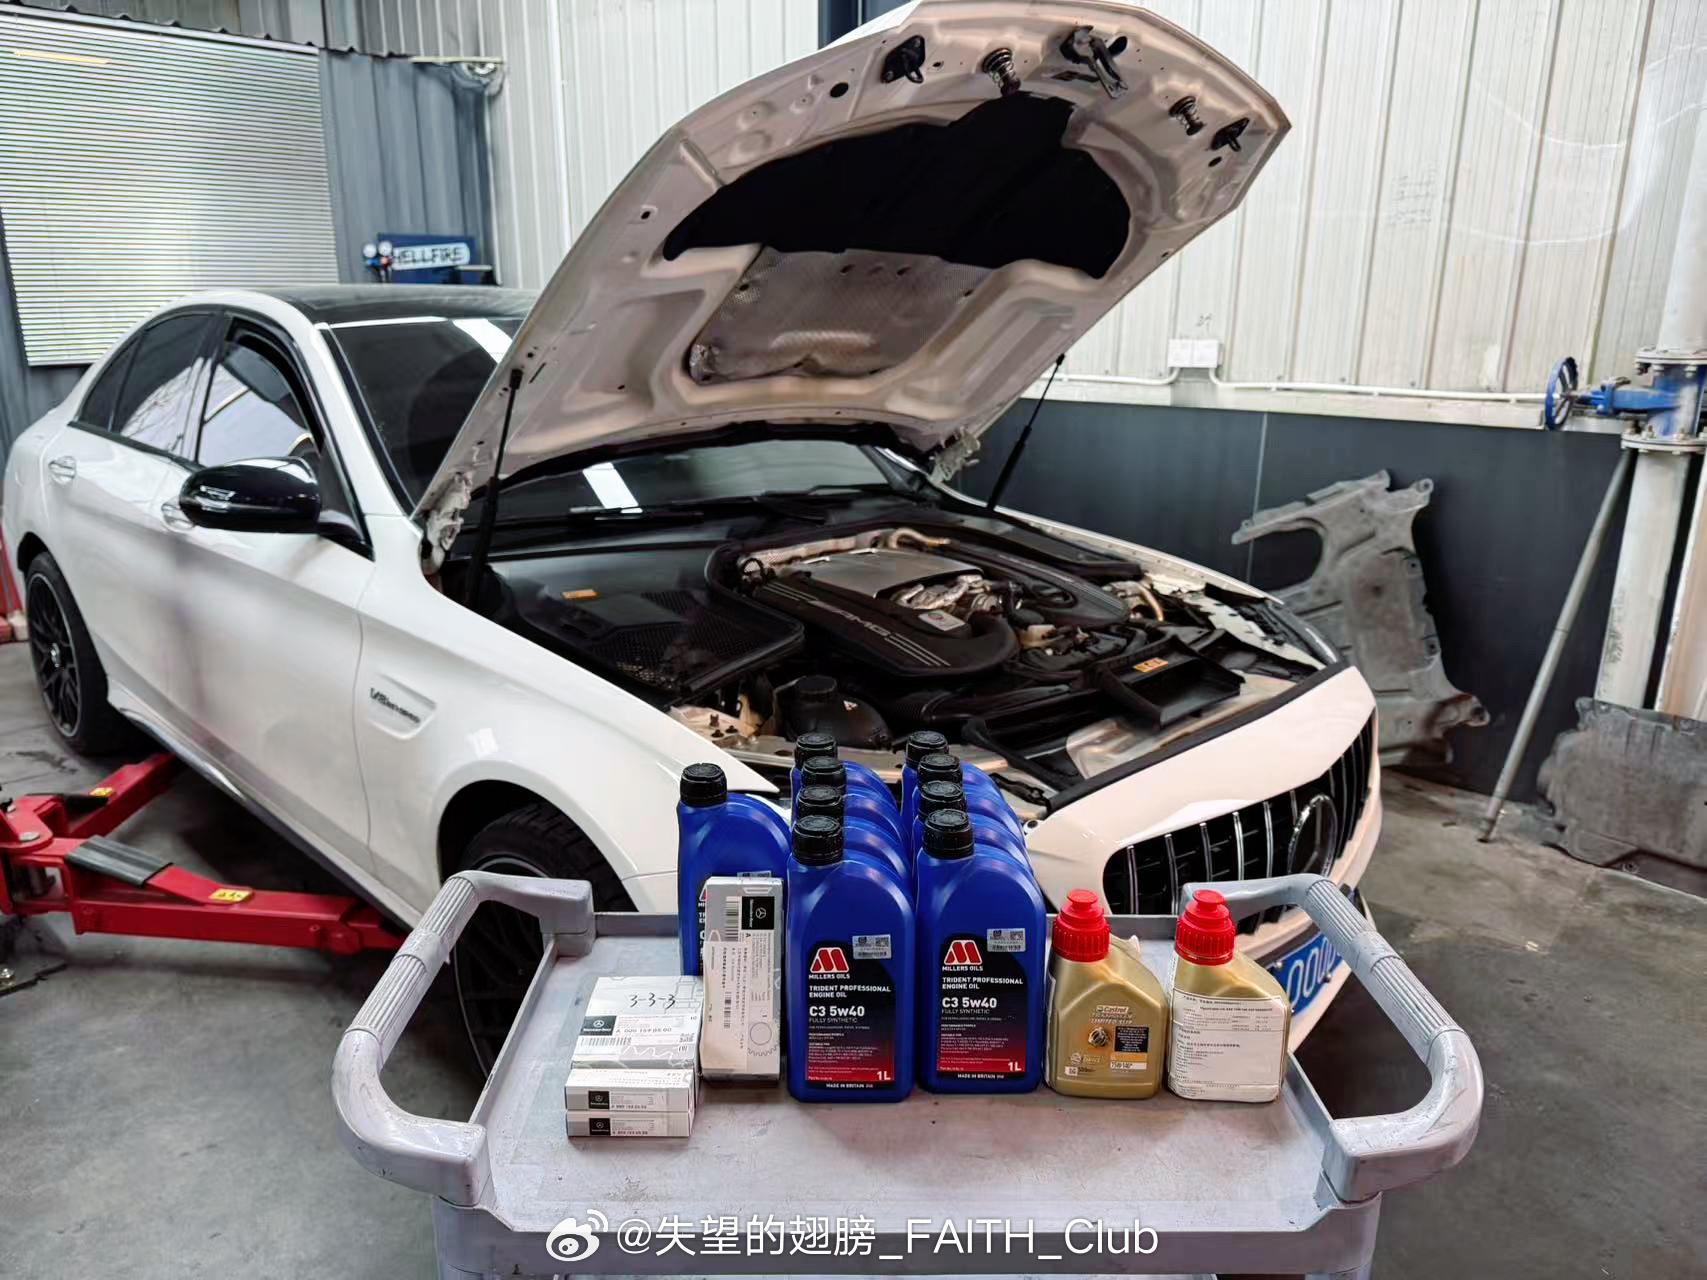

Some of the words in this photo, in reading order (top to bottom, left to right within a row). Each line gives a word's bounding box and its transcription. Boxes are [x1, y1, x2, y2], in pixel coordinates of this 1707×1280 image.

[942, 997, 959, 1008] C3
[962, 997, 998, 1008] 5w40
[809, 1005, 826, 1017] C3
[829, 1005, 865, 1017] 5w40
[1007, 1061, 1022, 1072] 1L
[877, 1070, 891, 1081] 1L
